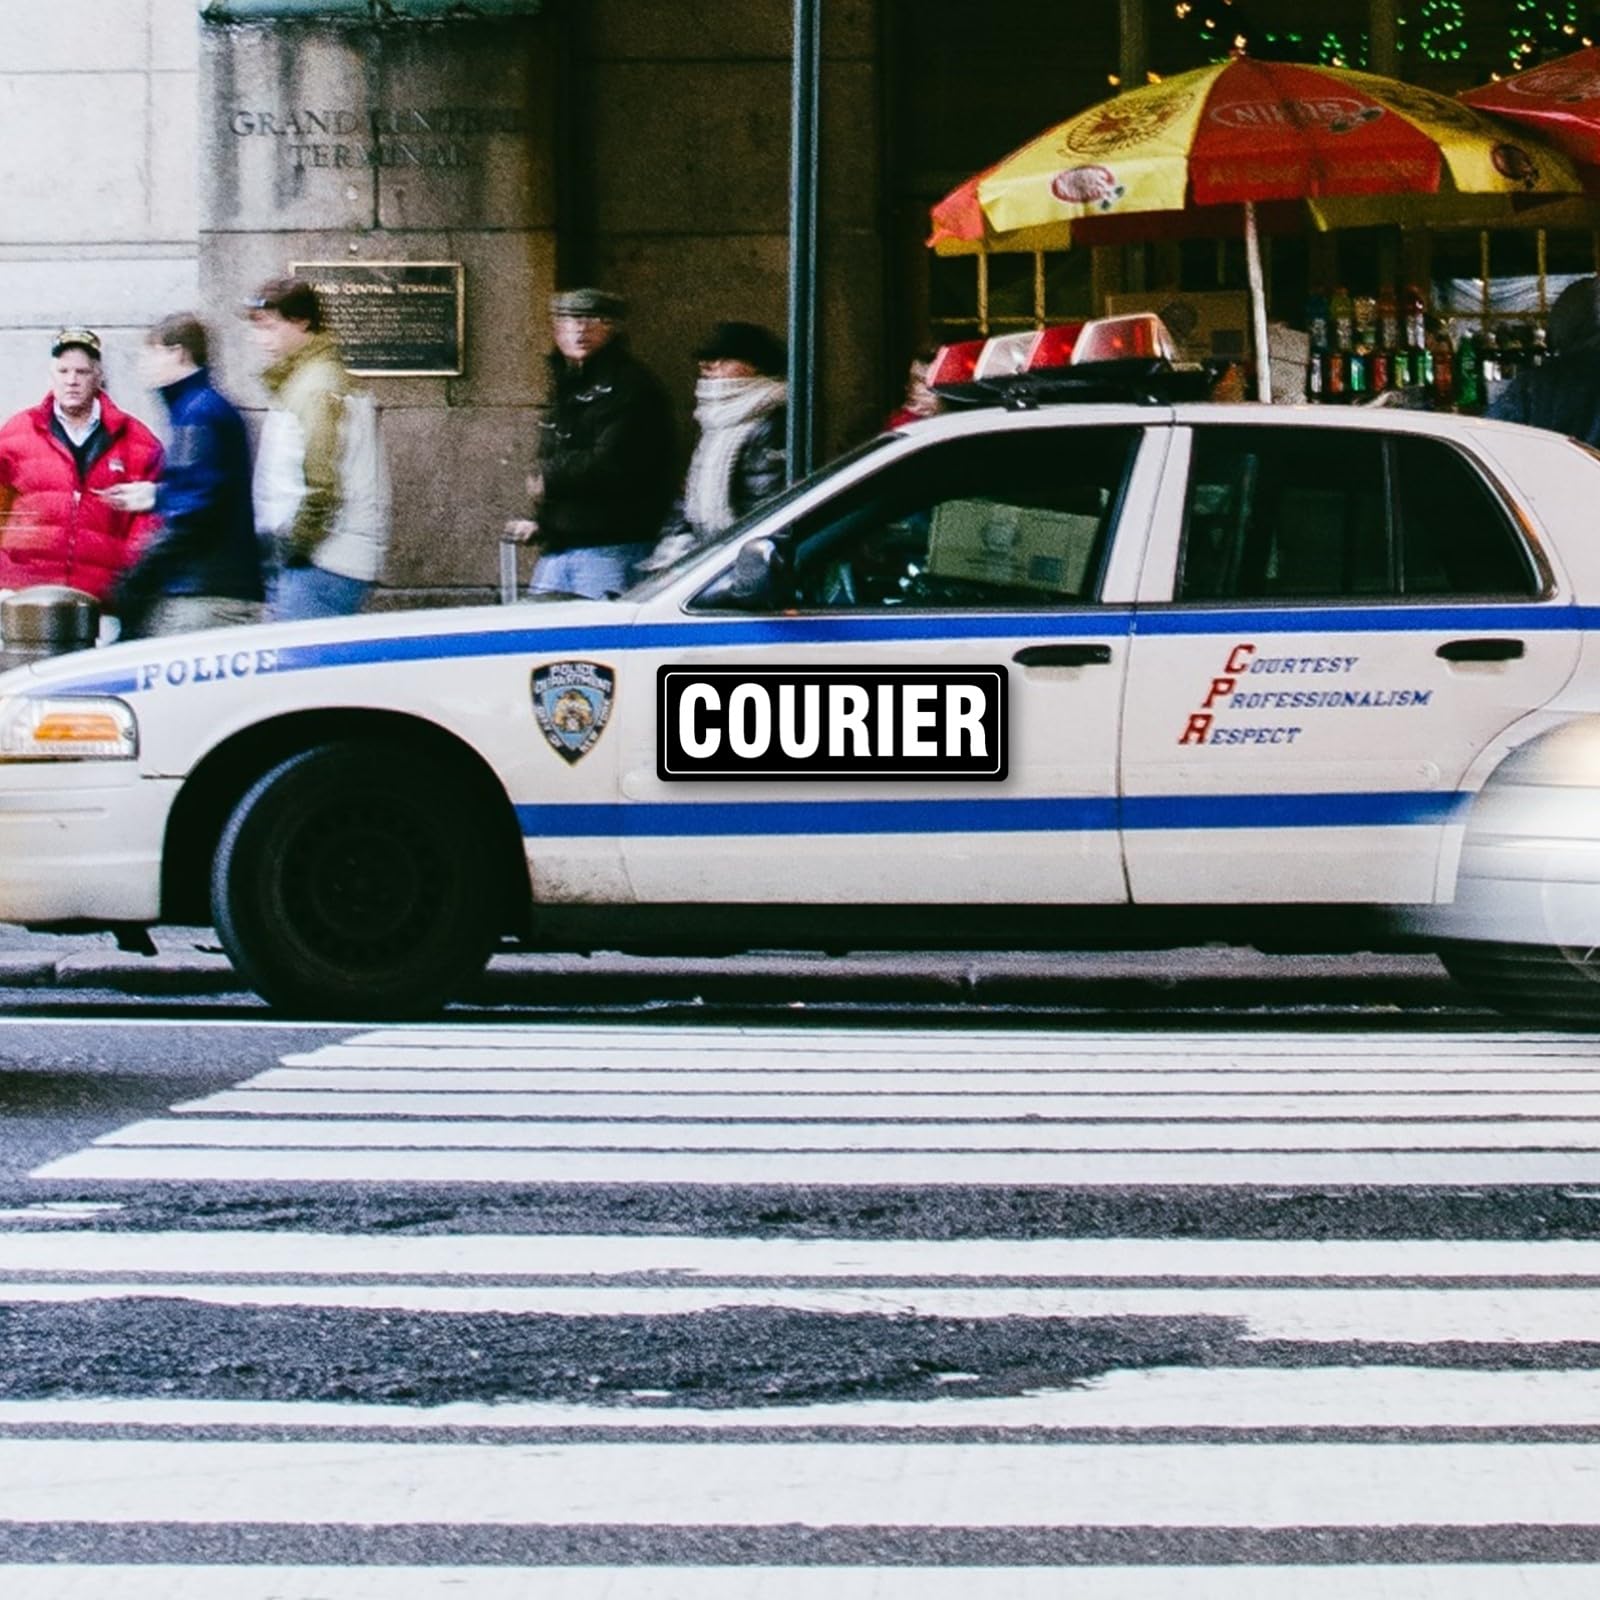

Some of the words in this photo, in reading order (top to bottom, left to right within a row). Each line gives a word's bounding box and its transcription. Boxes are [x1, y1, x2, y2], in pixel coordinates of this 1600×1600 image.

[229, 110, 357, 136] GRAND
[371, 108, 525, 134] ENTRL
[142, 649, 277, 691] POLICE
[550, 663, 595, 678] POLICE
[1223, 643, 1359, 675] COURTESY
[535, 673, 613, 694] DEPARTMENT
[1201, 677, 1434, 709] PROFESSIONALISM
[679, 682, 989, 759] COURIER
[1177, 713, 1302, 745] RESPECT
